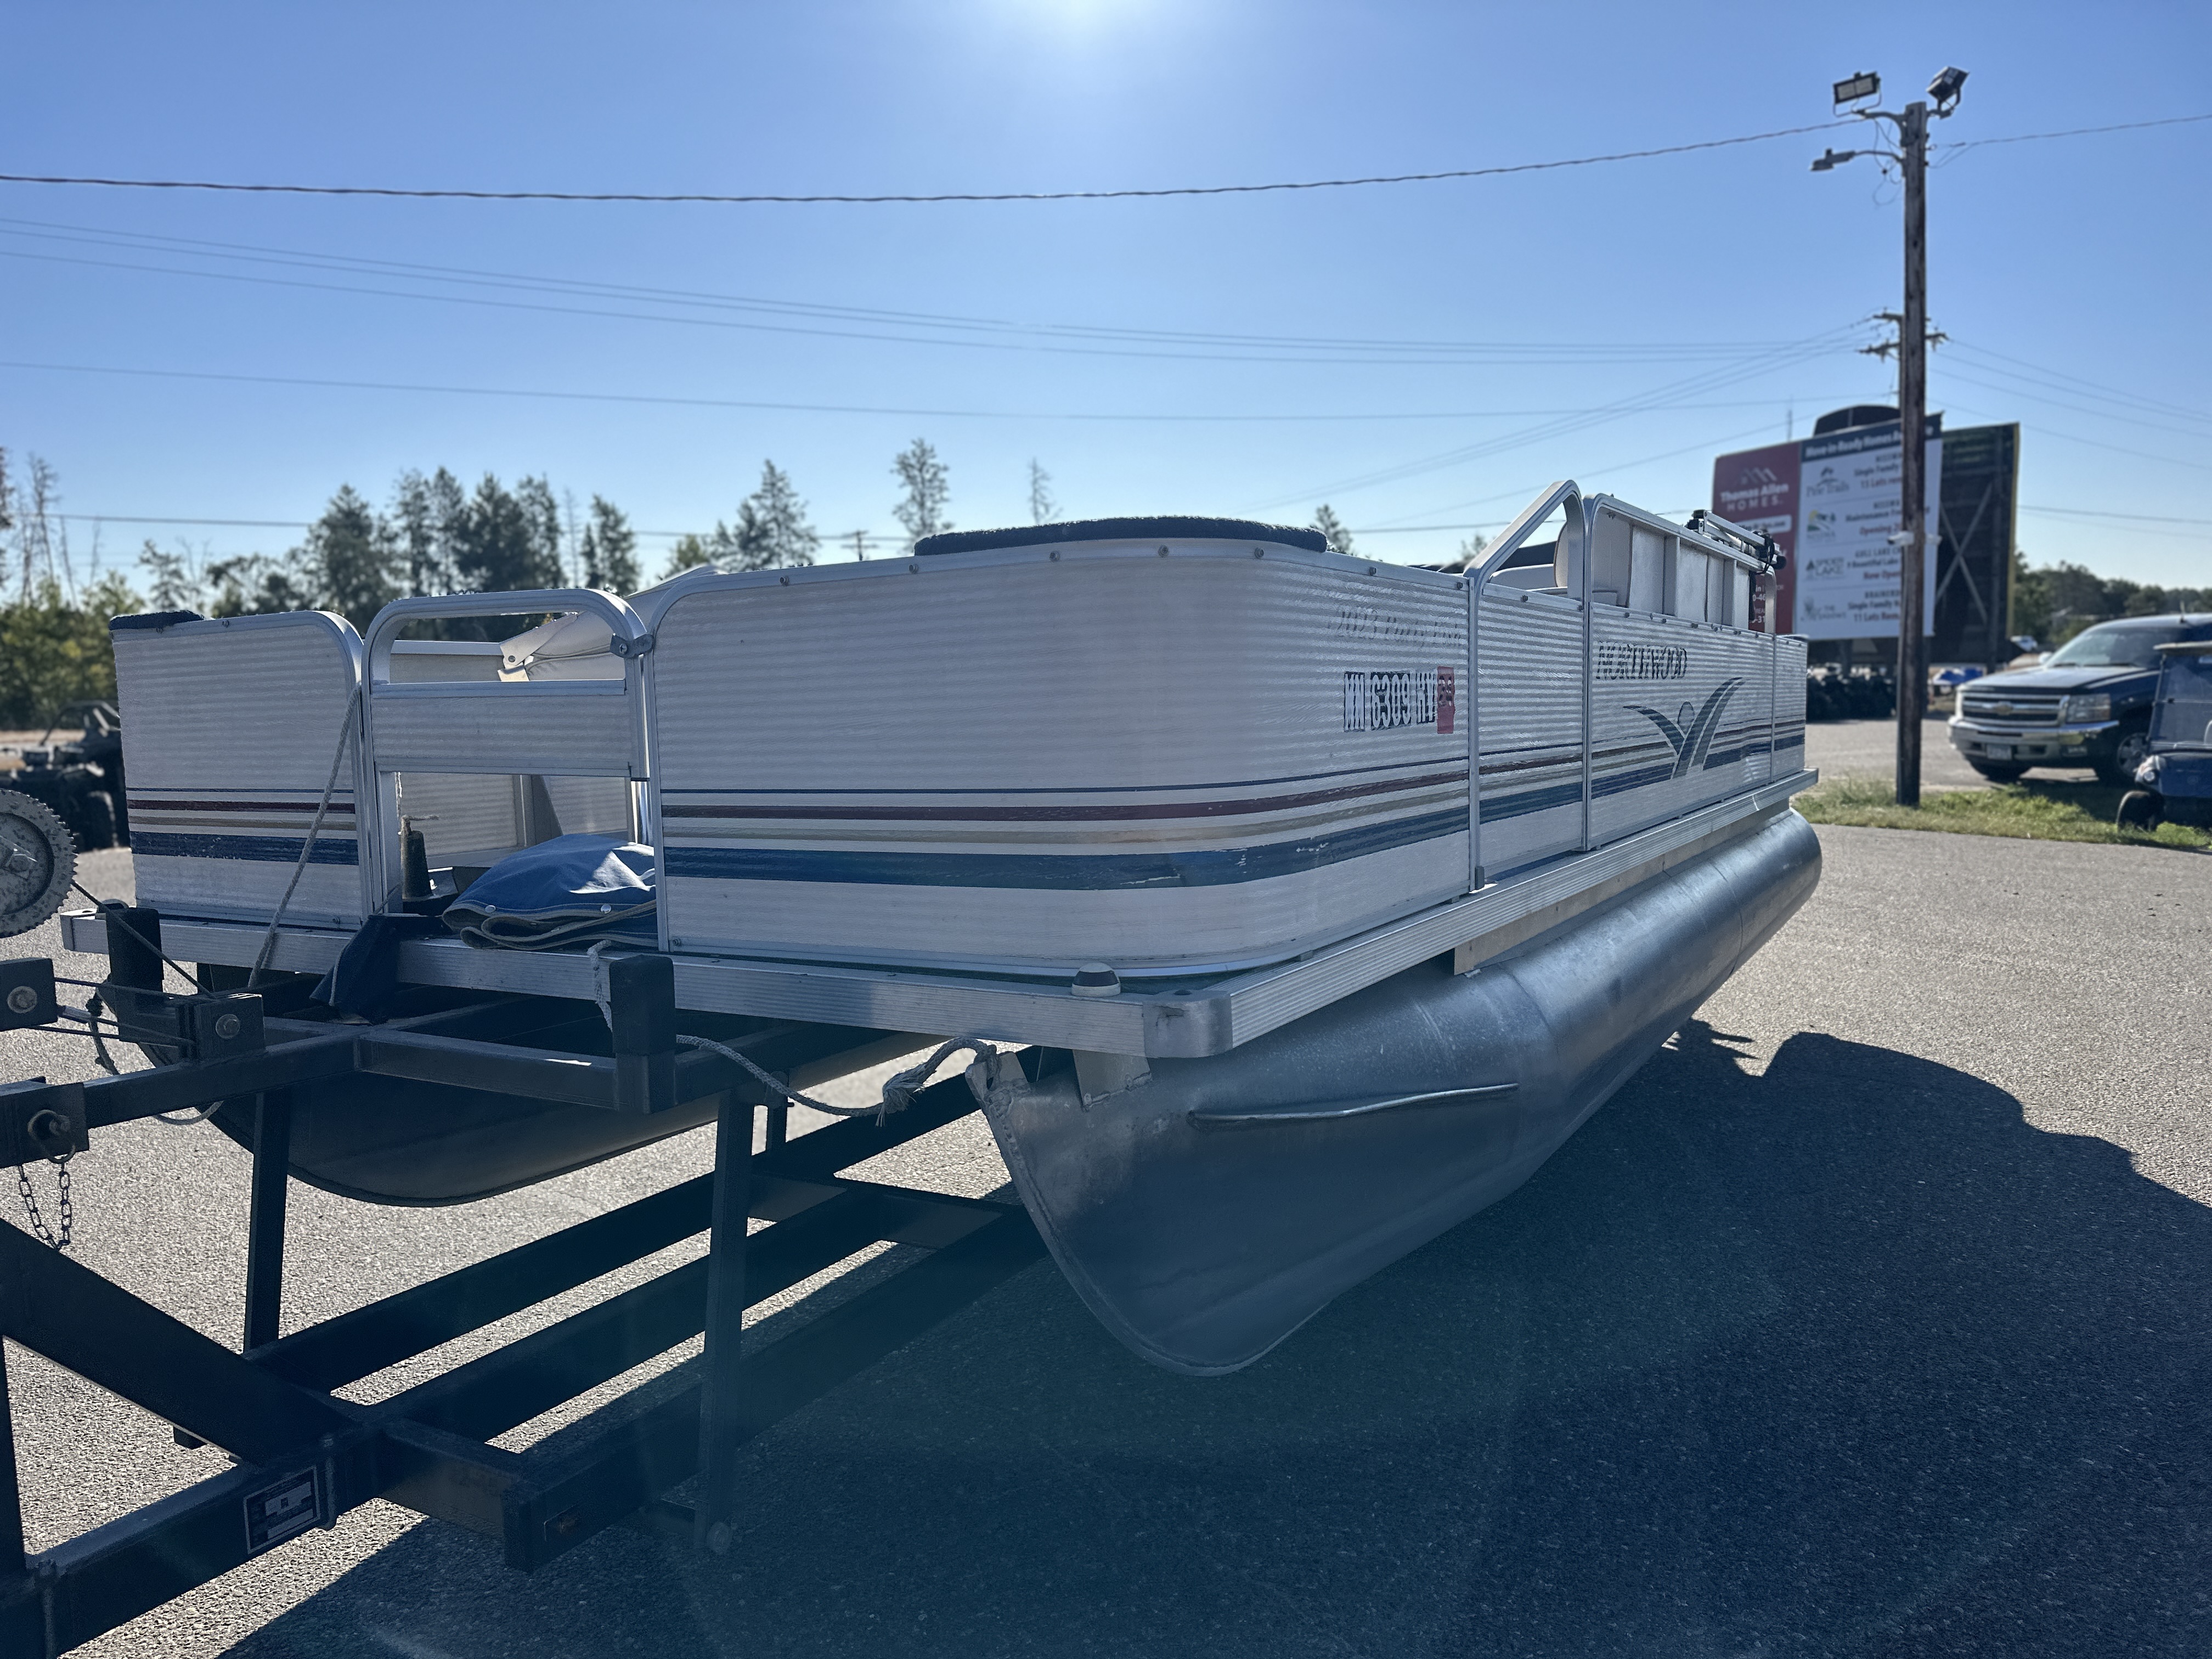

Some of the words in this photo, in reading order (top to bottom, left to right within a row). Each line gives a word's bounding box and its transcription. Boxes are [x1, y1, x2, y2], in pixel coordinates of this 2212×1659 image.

[1720, 488, 1759, 503] Thomas
[1760, 483, 1789, 495] Allen
[1371, 673, 1411, 729] 6309
